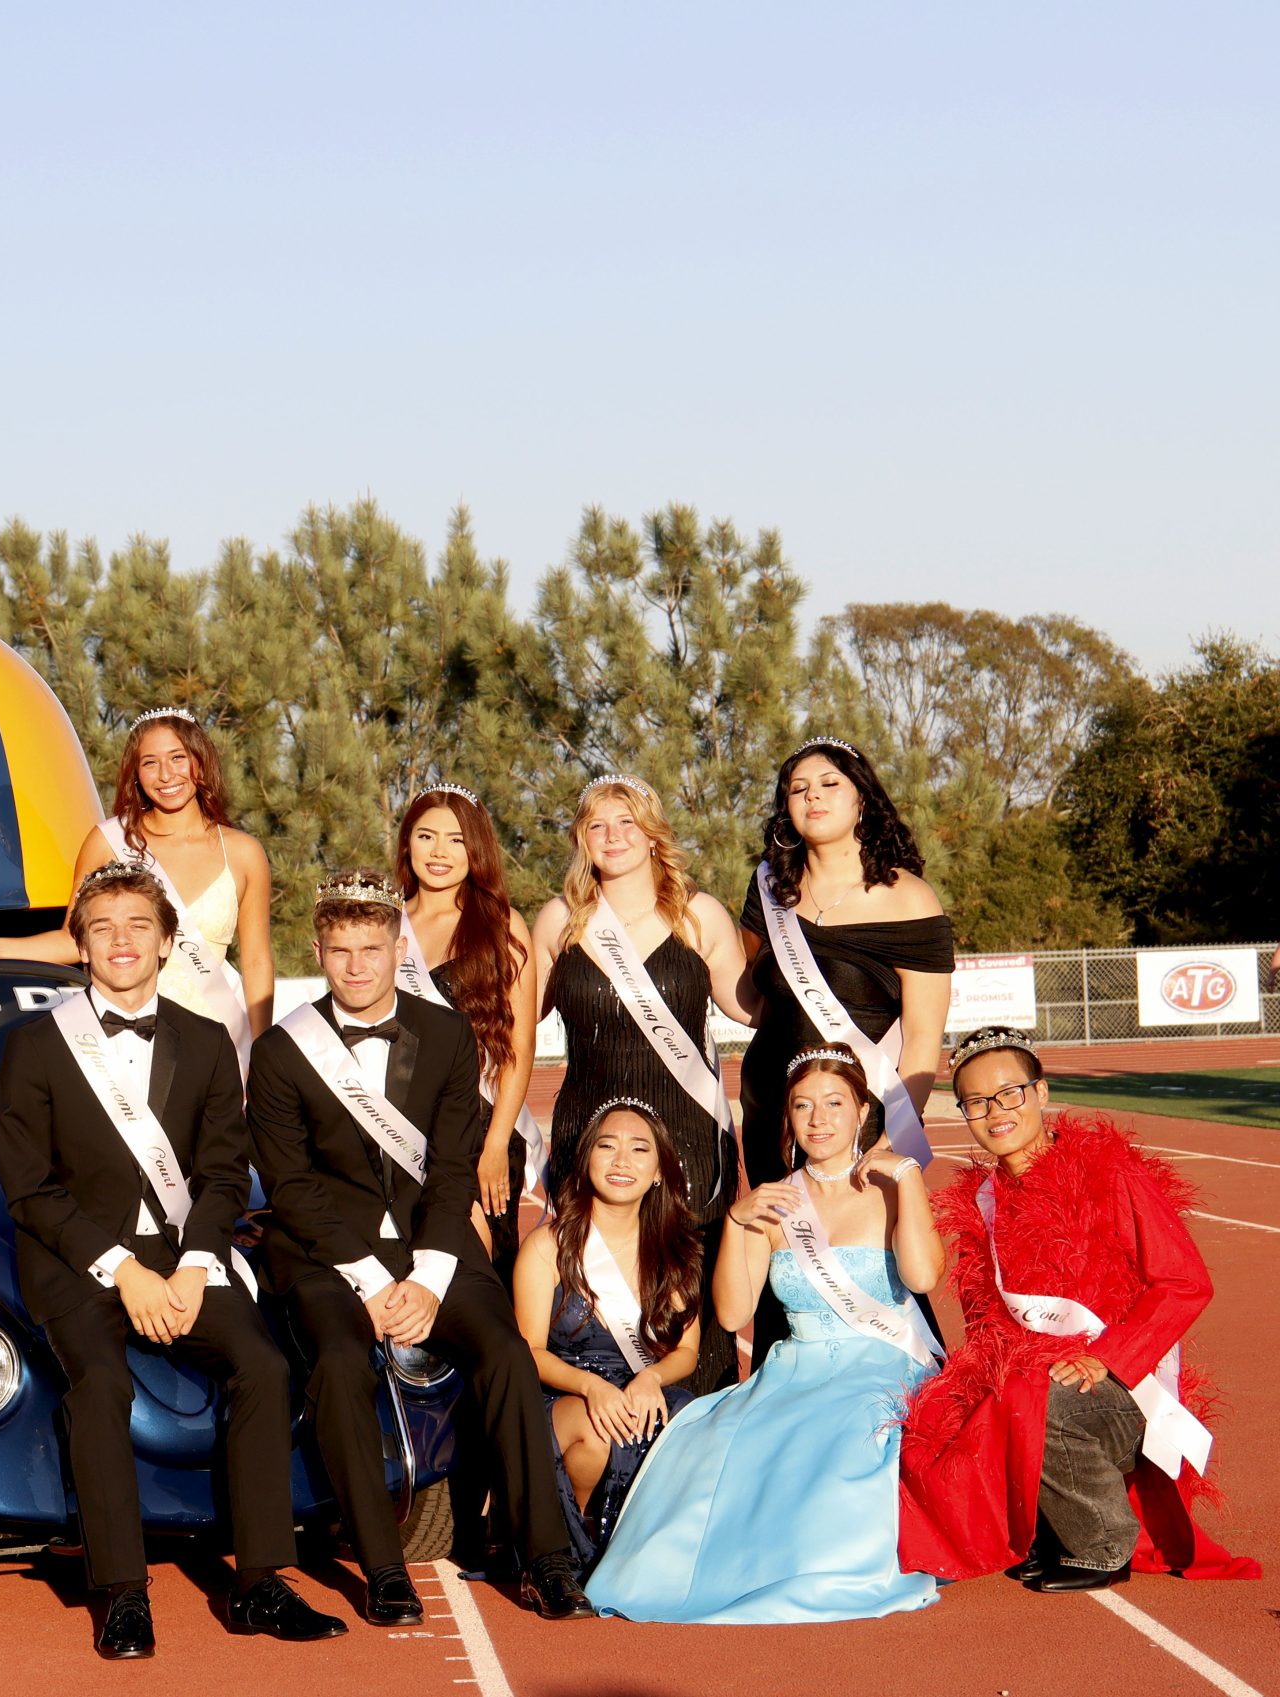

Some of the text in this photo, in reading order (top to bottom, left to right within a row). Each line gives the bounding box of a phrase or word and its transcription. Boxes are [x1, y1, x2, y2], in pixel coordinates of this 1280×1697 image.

[179, 941, 211, 974] Court
[595, 929, 689, 1061] Homecoming Court
[804, 989, 841, 1027] Court
[1170, 969, 1226, 1007] ATG
[337, 1078, 422, 1163] Homecoming
[147, 1147, 177, 1189] Court
[791, 1220, 902, 1337] Homecoming Court
